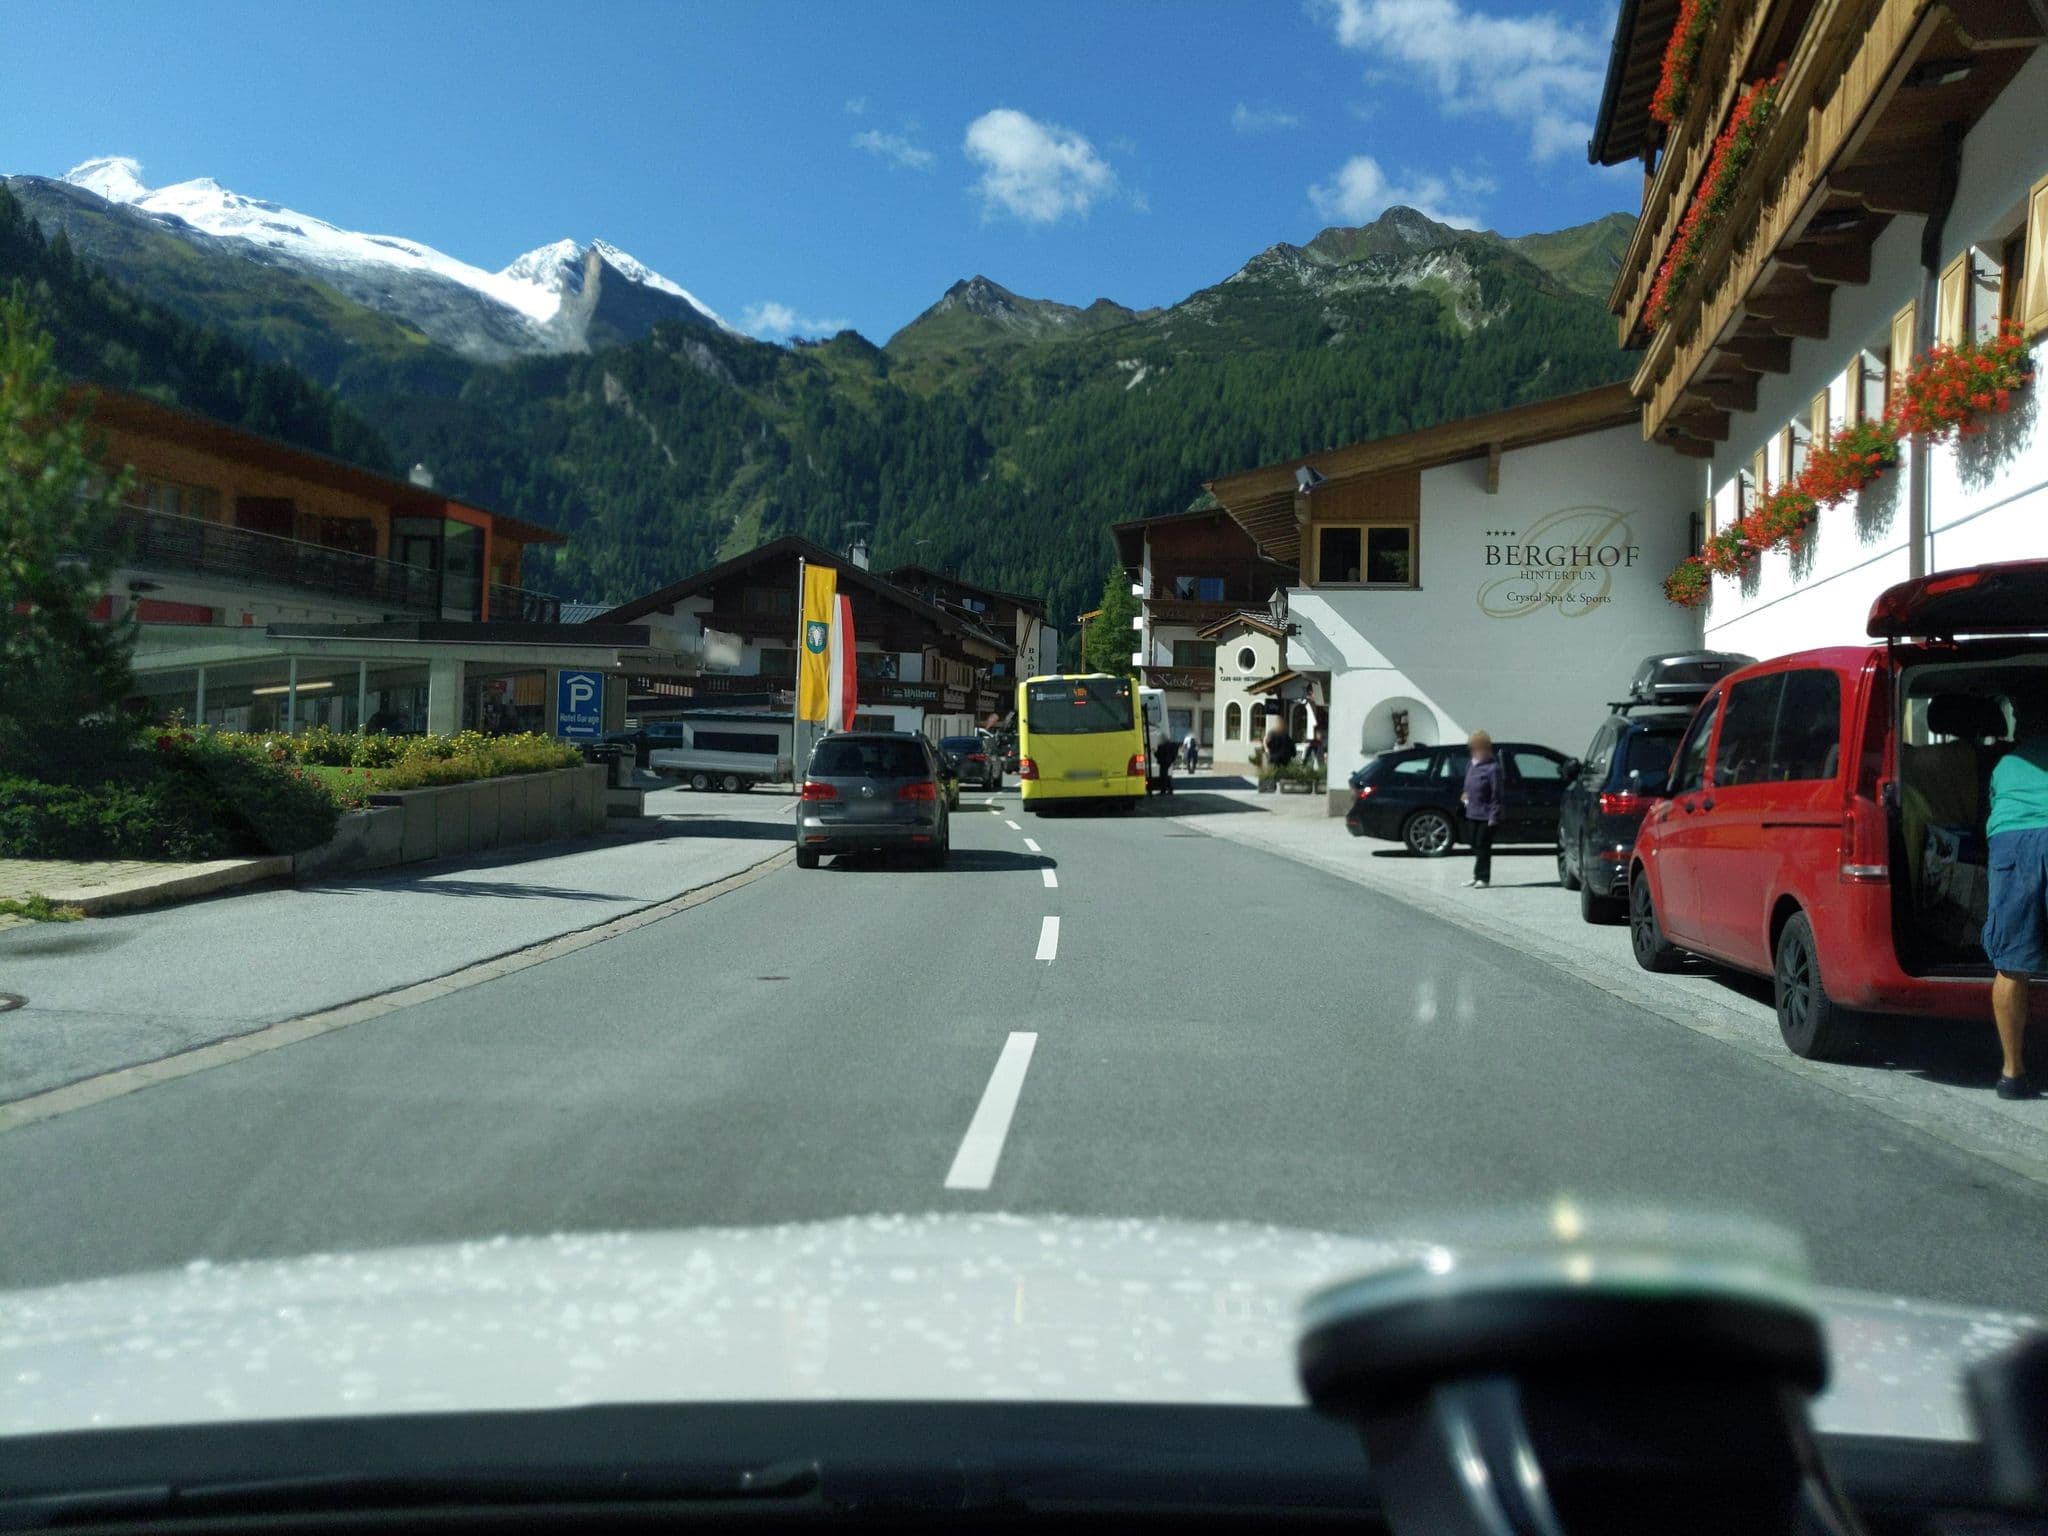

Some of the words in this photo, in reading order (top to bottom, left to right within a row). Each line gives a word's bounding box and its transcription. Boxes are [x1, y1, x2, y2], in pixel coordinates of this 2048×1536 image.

[1485, 545, 1640, 567] BERGHOF
[1520, 570, 1597, 580] HINTERTUX
[1506, 591, 1542, 603] Crystal
[1545, 592, 1563, 604] Spa
[1566, 592, 1576, 602] &
[1579, 592, 1611, 605] Sports
[570, 683, 594, 713] P
[560, 712, 576, 722] Hotel
[577, 713, 600, 725] Garage
